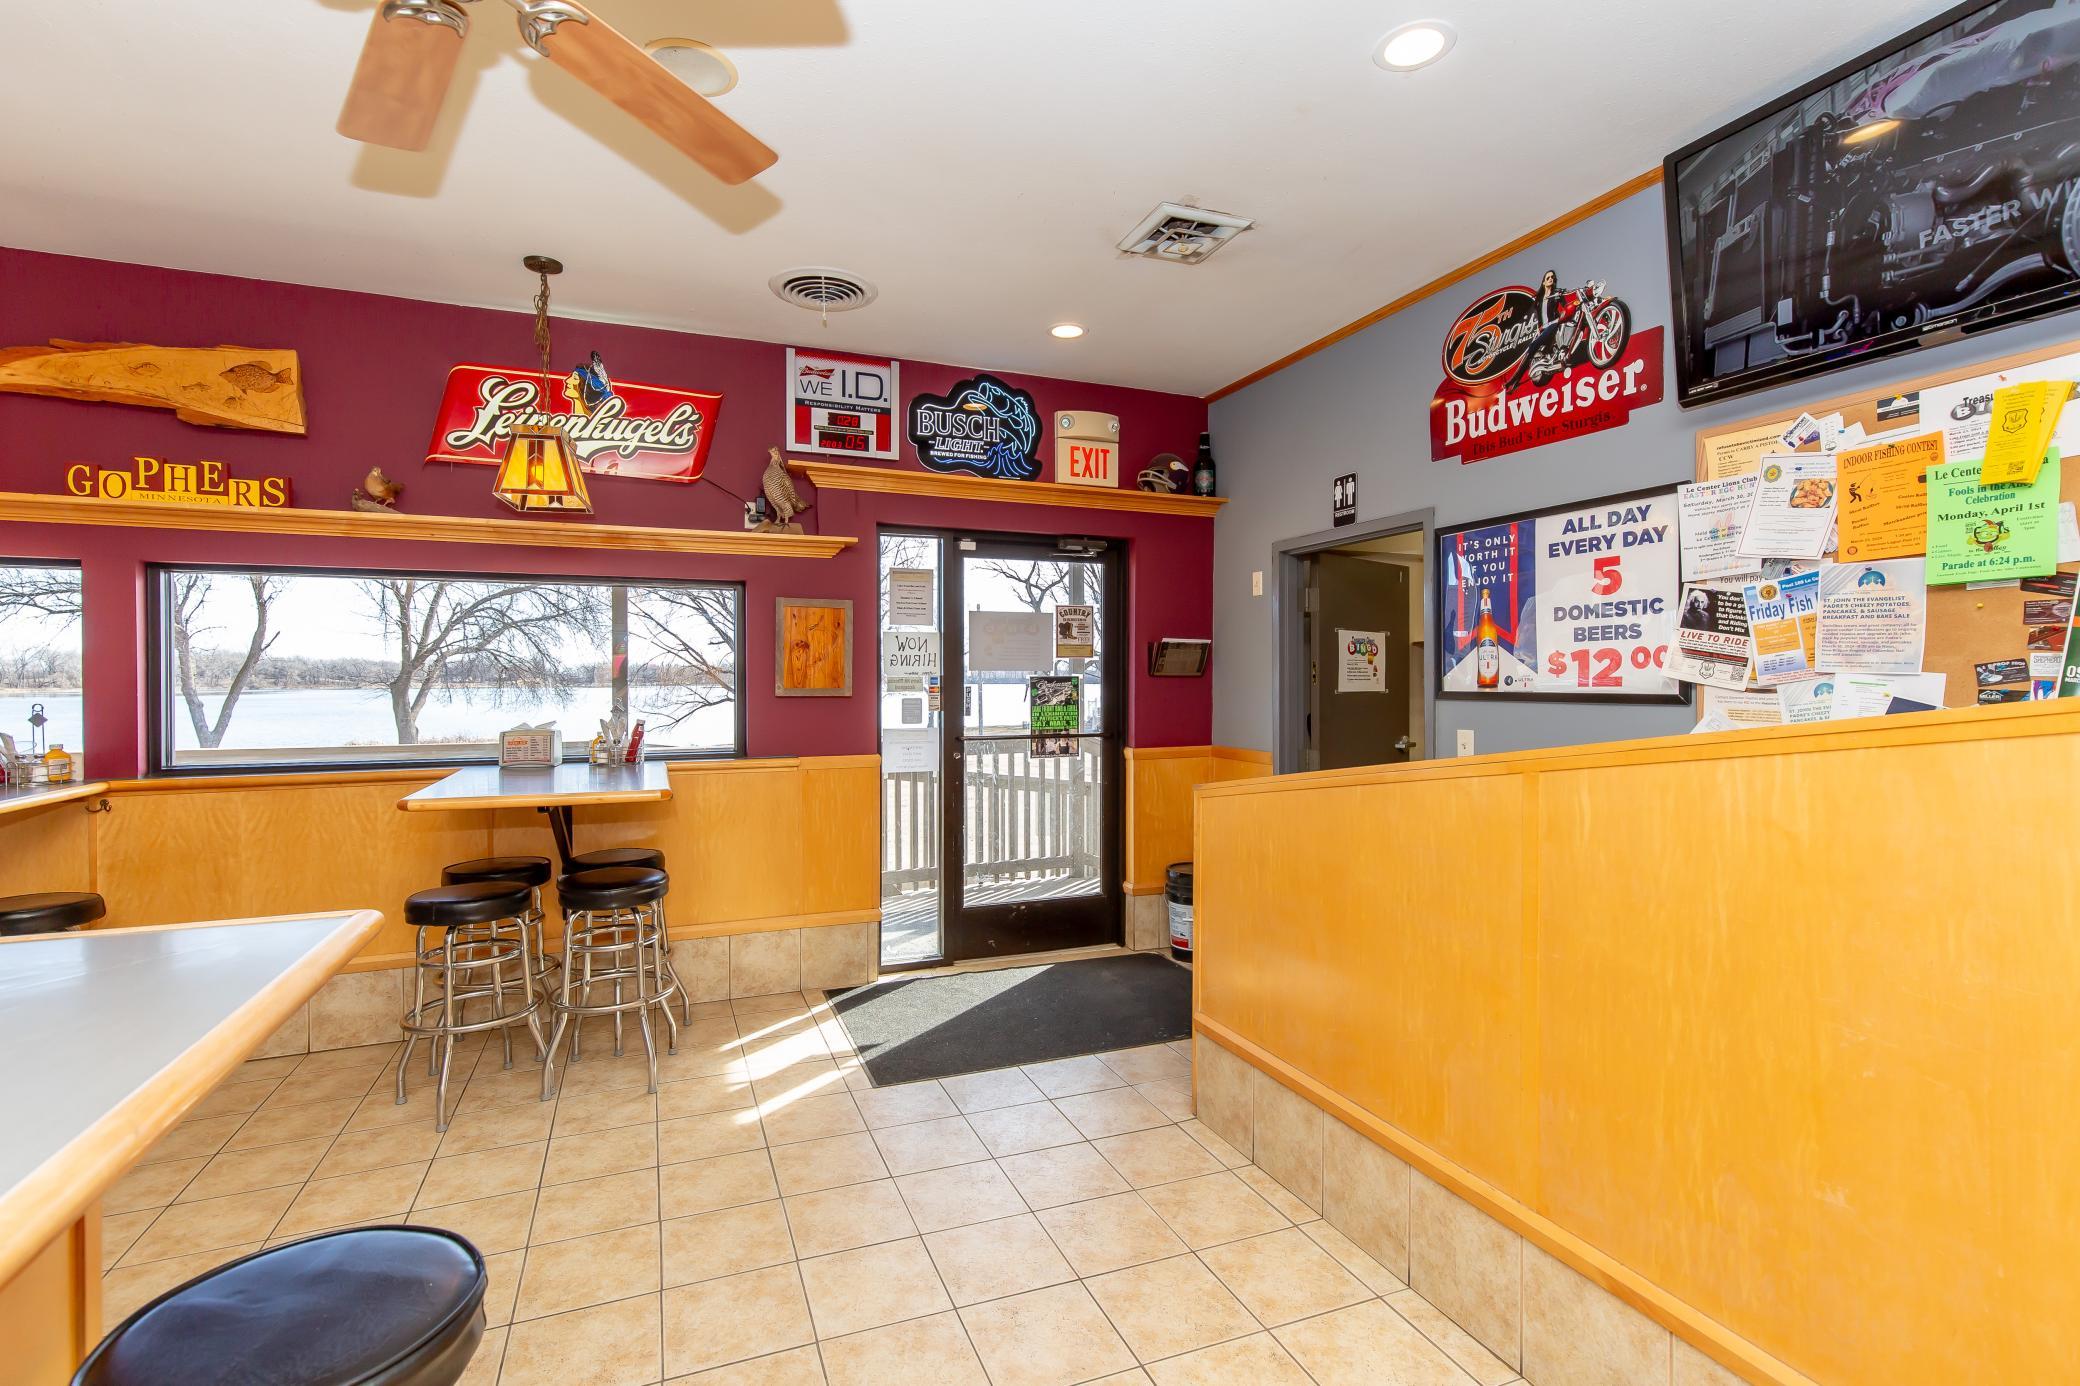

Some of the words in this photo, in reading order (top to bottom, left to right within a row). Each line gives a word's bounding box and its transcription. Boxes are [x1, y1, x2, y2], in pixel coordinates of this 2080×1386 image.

[1918, 200, 2022, 249] FASTER
[800, 379, 833, 396] WE
[842, 369, 888, 402] I.D.
[1445, 358, 1645, 445] Budweiser
[917, 409, 1000, 442] BUSCH
[1473, 439, 1496, 456] This
[1500, 430, 1533, 451] Bud's
[1536, 424, 1559, 439] For
[1843, 451, 1874, 469] INDOOR
[1874, 444, 1906, 461] FISHING
[1906, 439, 1938, 456] CONTEST
[1070, 446, 1110, 480] EXIT
[1934, 469, 1949, 481] Le
[1950, 465, 1982, 478] Cente
[67, 456, 287, 508] GOPHERS
[1697, 484, 1721, 492] Center
[1742, 476, 1758, 484] Club
[1737, 481, 1756, 491] HUN
[1948, 485, 1975, 497] Fools
[1977, 484, 1988, 493] in
[139, 491, 222, 505] MINNESOTA
[1965, 491, 2016, 505] Celebration
[1562, 514, 1602, 536] ALL
[1607, 504, 1653, 528] DAY
[1937, 510, 1989, 523] Monday,
[1991, 502, 2024, 515] April
[2028, 501, 2046, 511] 1st
[1458, 540, 1480, 552] IT'S
[1485, 534, 1516, 547] ONLY
[1548, 533, 1616, 559] EVERY
[1622, 525, 1669, 548] DAY
[1504, 547, 1516, 557] IT
[1482, 561, 1506, 573] YOU
[1942, 560, 1975, 571] Parade
[1977, 558, 1988, 567] at
[1989, 556, 2011, 566] 6:24
[2013, 554, 2036, 565] p.m.
[1461, 575, 1497, 588] ENJOY
[1502, 573, 1514, 582] IT
[1591, 555, 1623, 596] 5
[1719, 576, 1731, 584] You
[1731, 574, 1748, 583] will
[1749, 574, 1762, 584] pay
[1781, 581, 1795, 589] Post
[1058, 608, 1091, 618] COUNTRY
[1553, 597, 1664, 622] DOMESTIC
[1748, 602, 1786, 621] Friday
[1788, 594, 1814, 614] Fish
[1729, 620, 1748, 628] Riding
[1573, 623, 1643, 643] BEERS
[1680, 630, 1705, 641] LIVE
[1707, 634, 1720, 643] TO
[1723, 636, 1750, 647] RIDE
[1349, 642, 1377, 655] BINGO
